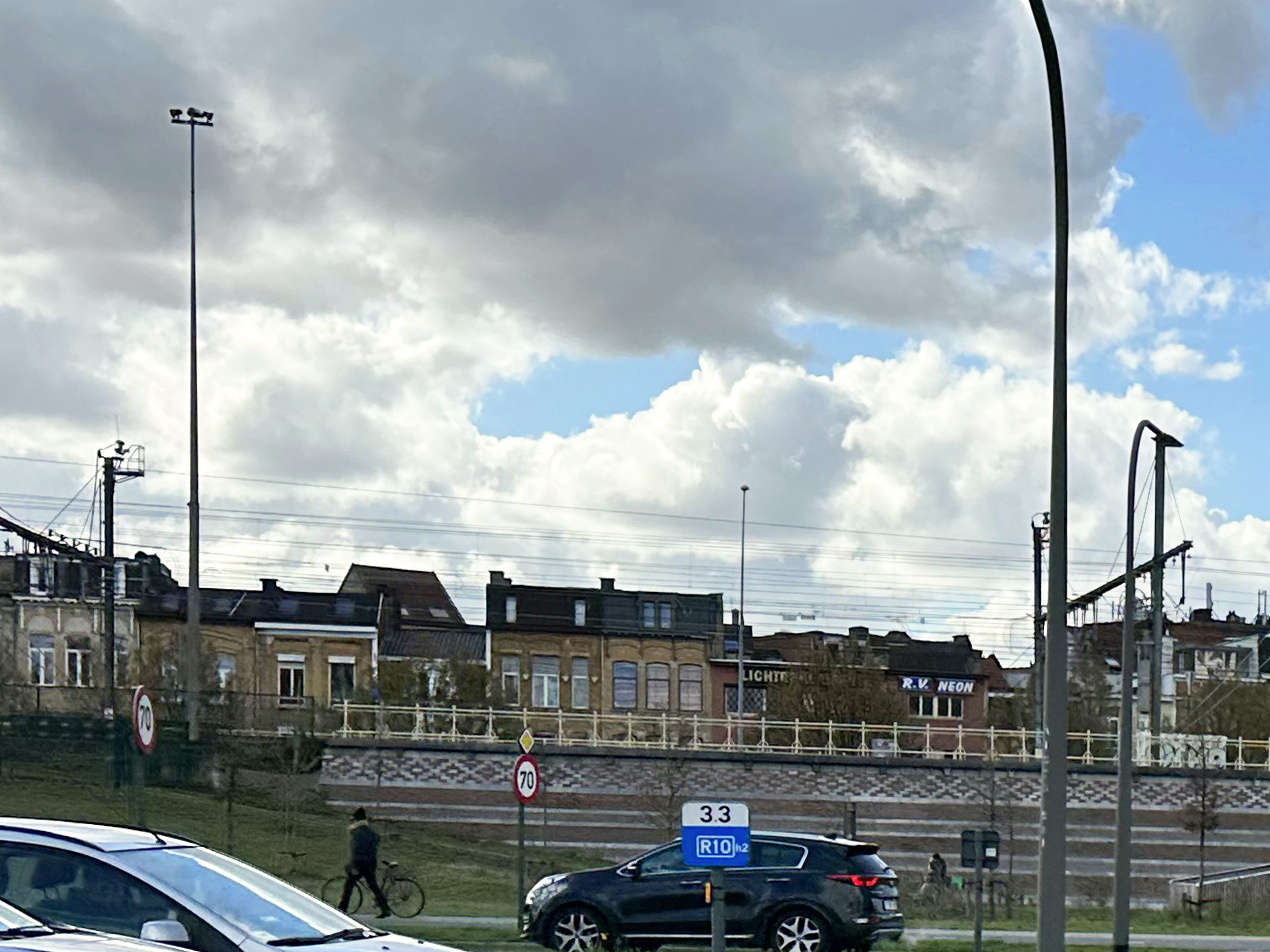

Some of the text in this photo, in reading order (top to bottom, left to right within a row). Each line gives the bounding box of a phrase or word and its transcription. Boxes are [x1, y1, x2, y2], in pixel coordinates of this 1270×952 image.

[902, 677, 929, 689] R.V.
[937, 681, 974, 693] NEON
[140, 705, 152, 731] 70
[520, 771, 534, 790] 70
[700, 805, 731, 823] 3.3
[700, 839, 749, 854] R10 h2
